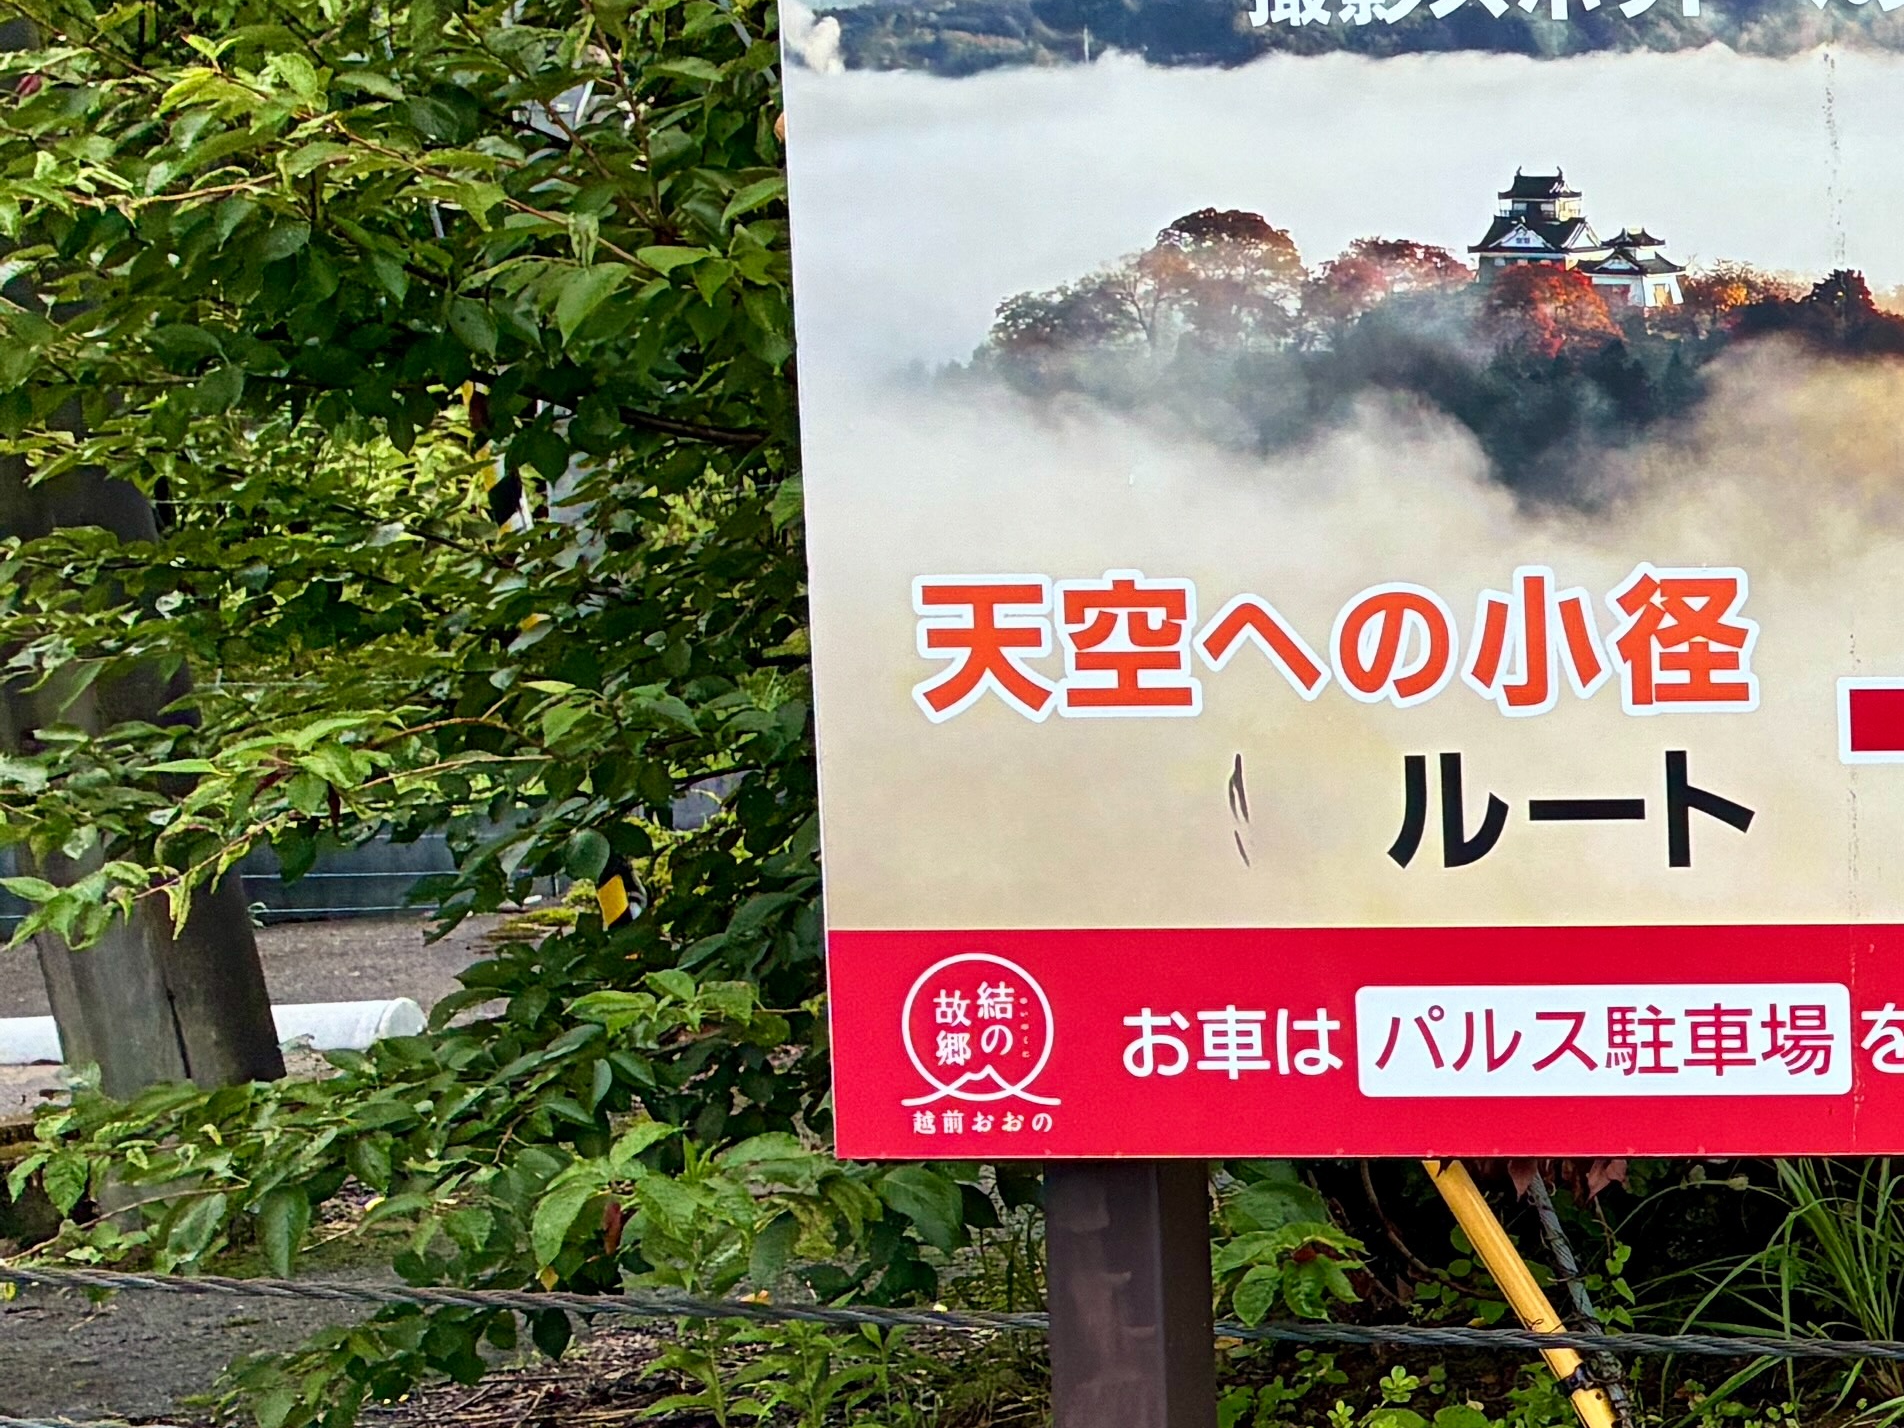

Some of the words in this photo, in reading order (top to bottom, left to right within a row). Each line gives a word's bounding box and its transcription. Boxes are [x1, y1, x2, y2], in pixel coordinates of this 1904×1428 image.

[918, 574, 1751, 714] 天空への小径
[1387, 750, 1755, 869] ルート
[912, 1110, 1053, 1135] 越前おおの
